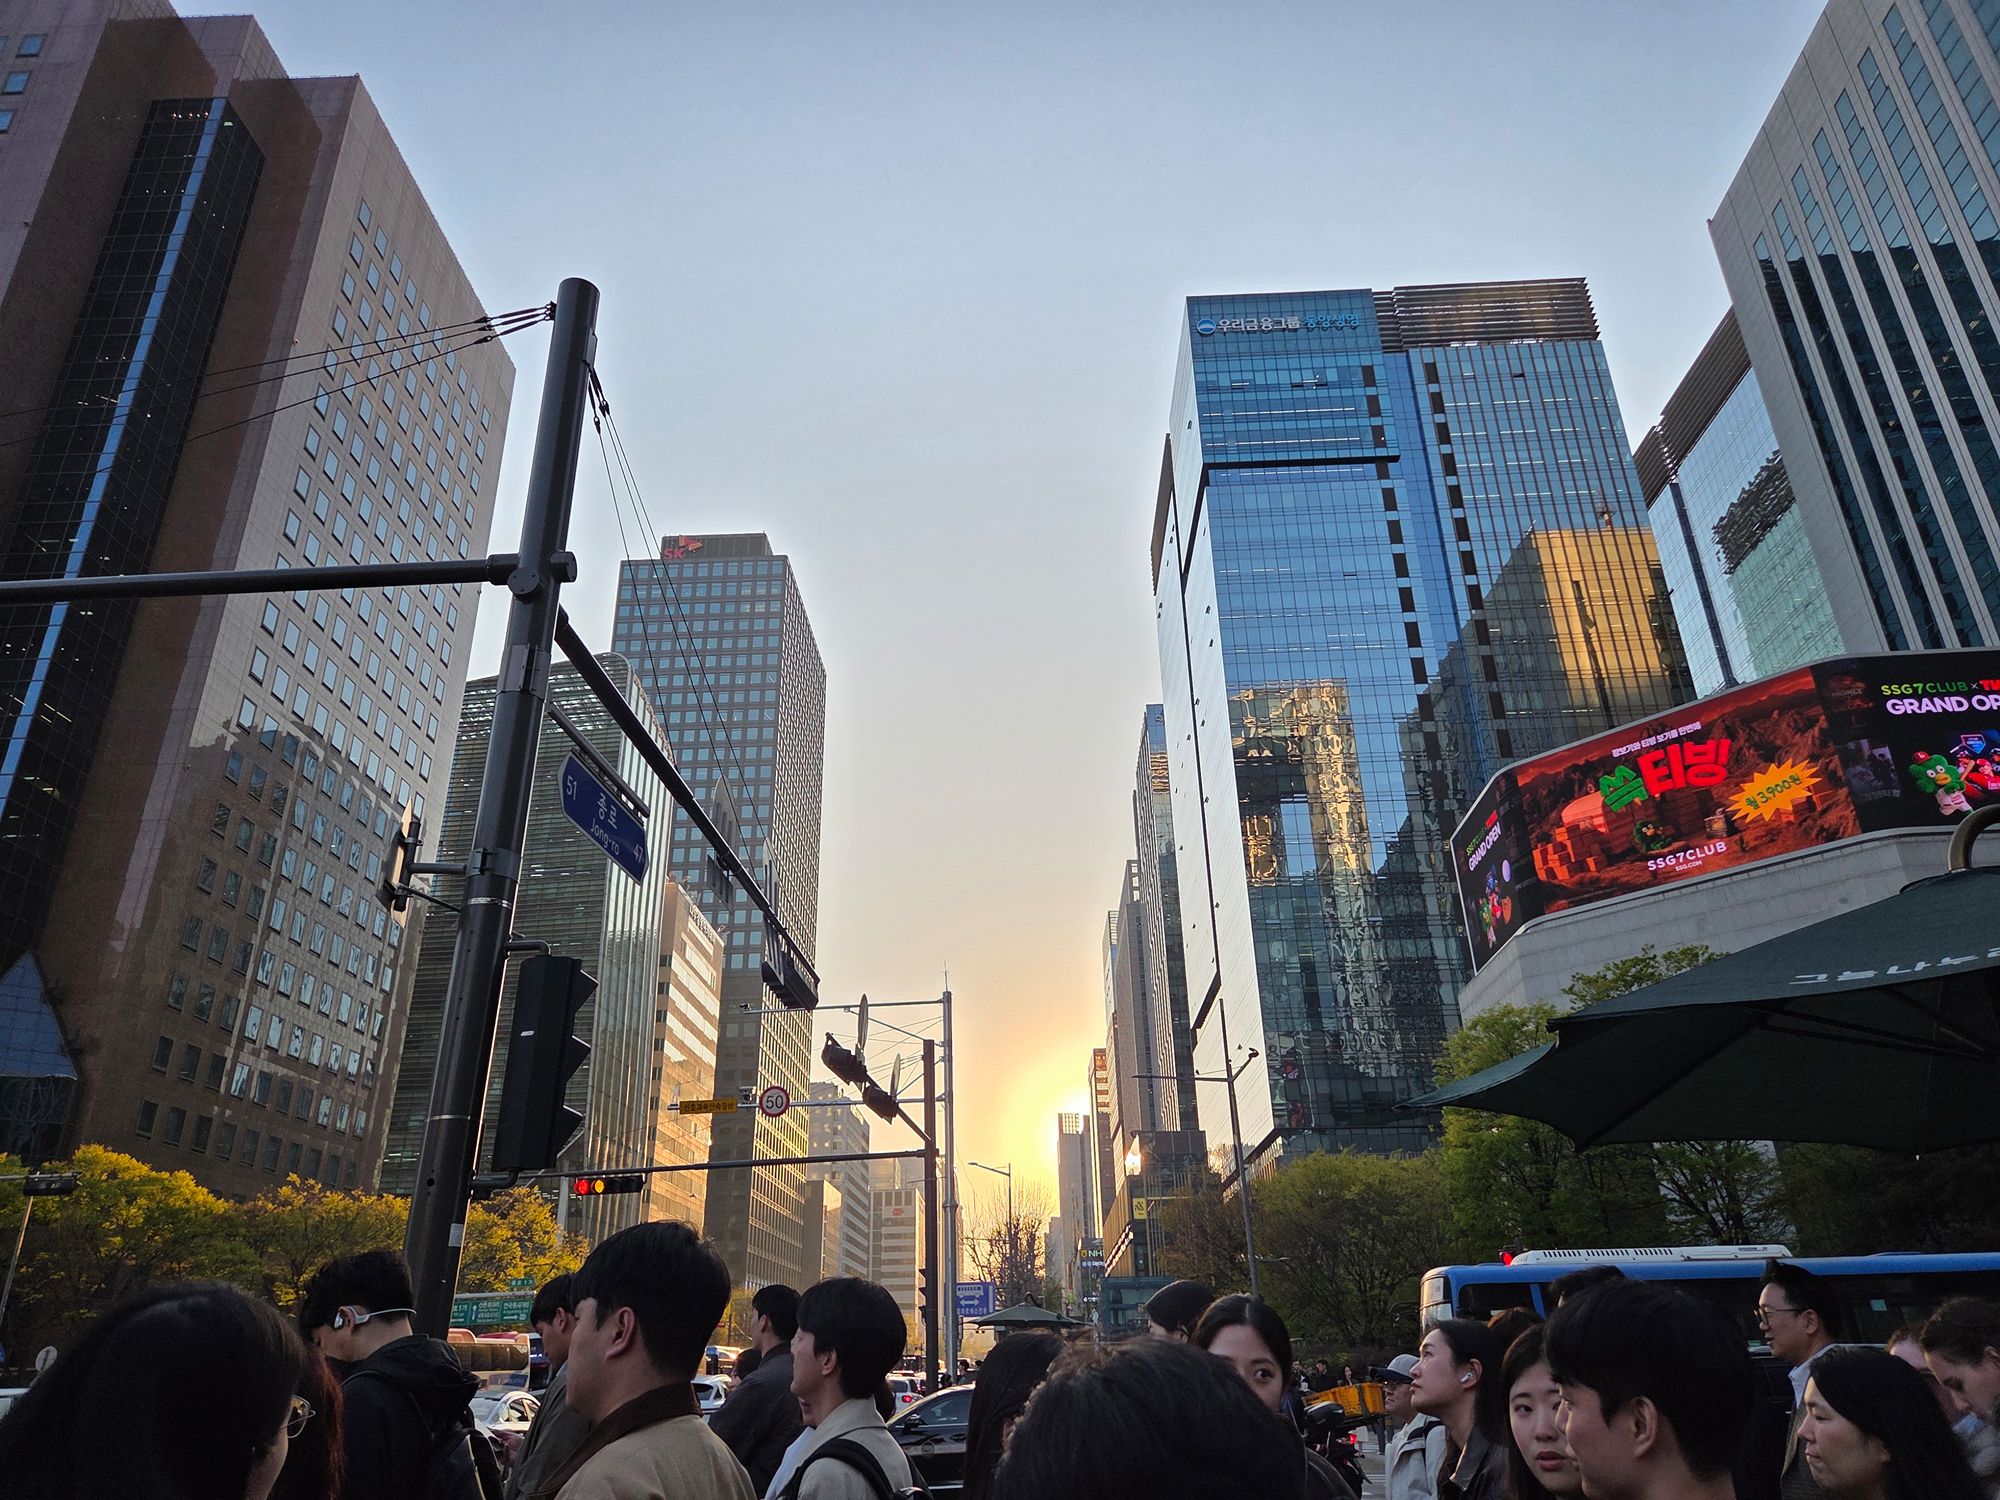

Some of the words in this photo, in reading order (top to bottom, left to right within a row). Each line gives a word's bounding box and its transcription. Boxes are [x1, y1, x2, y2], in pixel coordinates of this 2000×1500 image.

[1218, 316, 1300, 333] 우리금융그룹
[1305, 313, 1360, 329] 동양생명
[663, 548, 686, 560] SK
[1886, 696, 1969, 716] GRAND
[566, 775, 577, 800] 51
[597, 792, 618, 830] 종로
[590, 818, 620, 855] Jong-ro
[1468, 841, 1487, 872] GRAND
[1485, 821, 1501, 850] OPEN
[633, 843, 644, 863] 47
[1647, 841, 1727, 871] SSG7CLUB
[765, 1095, 784, 1109] 50
